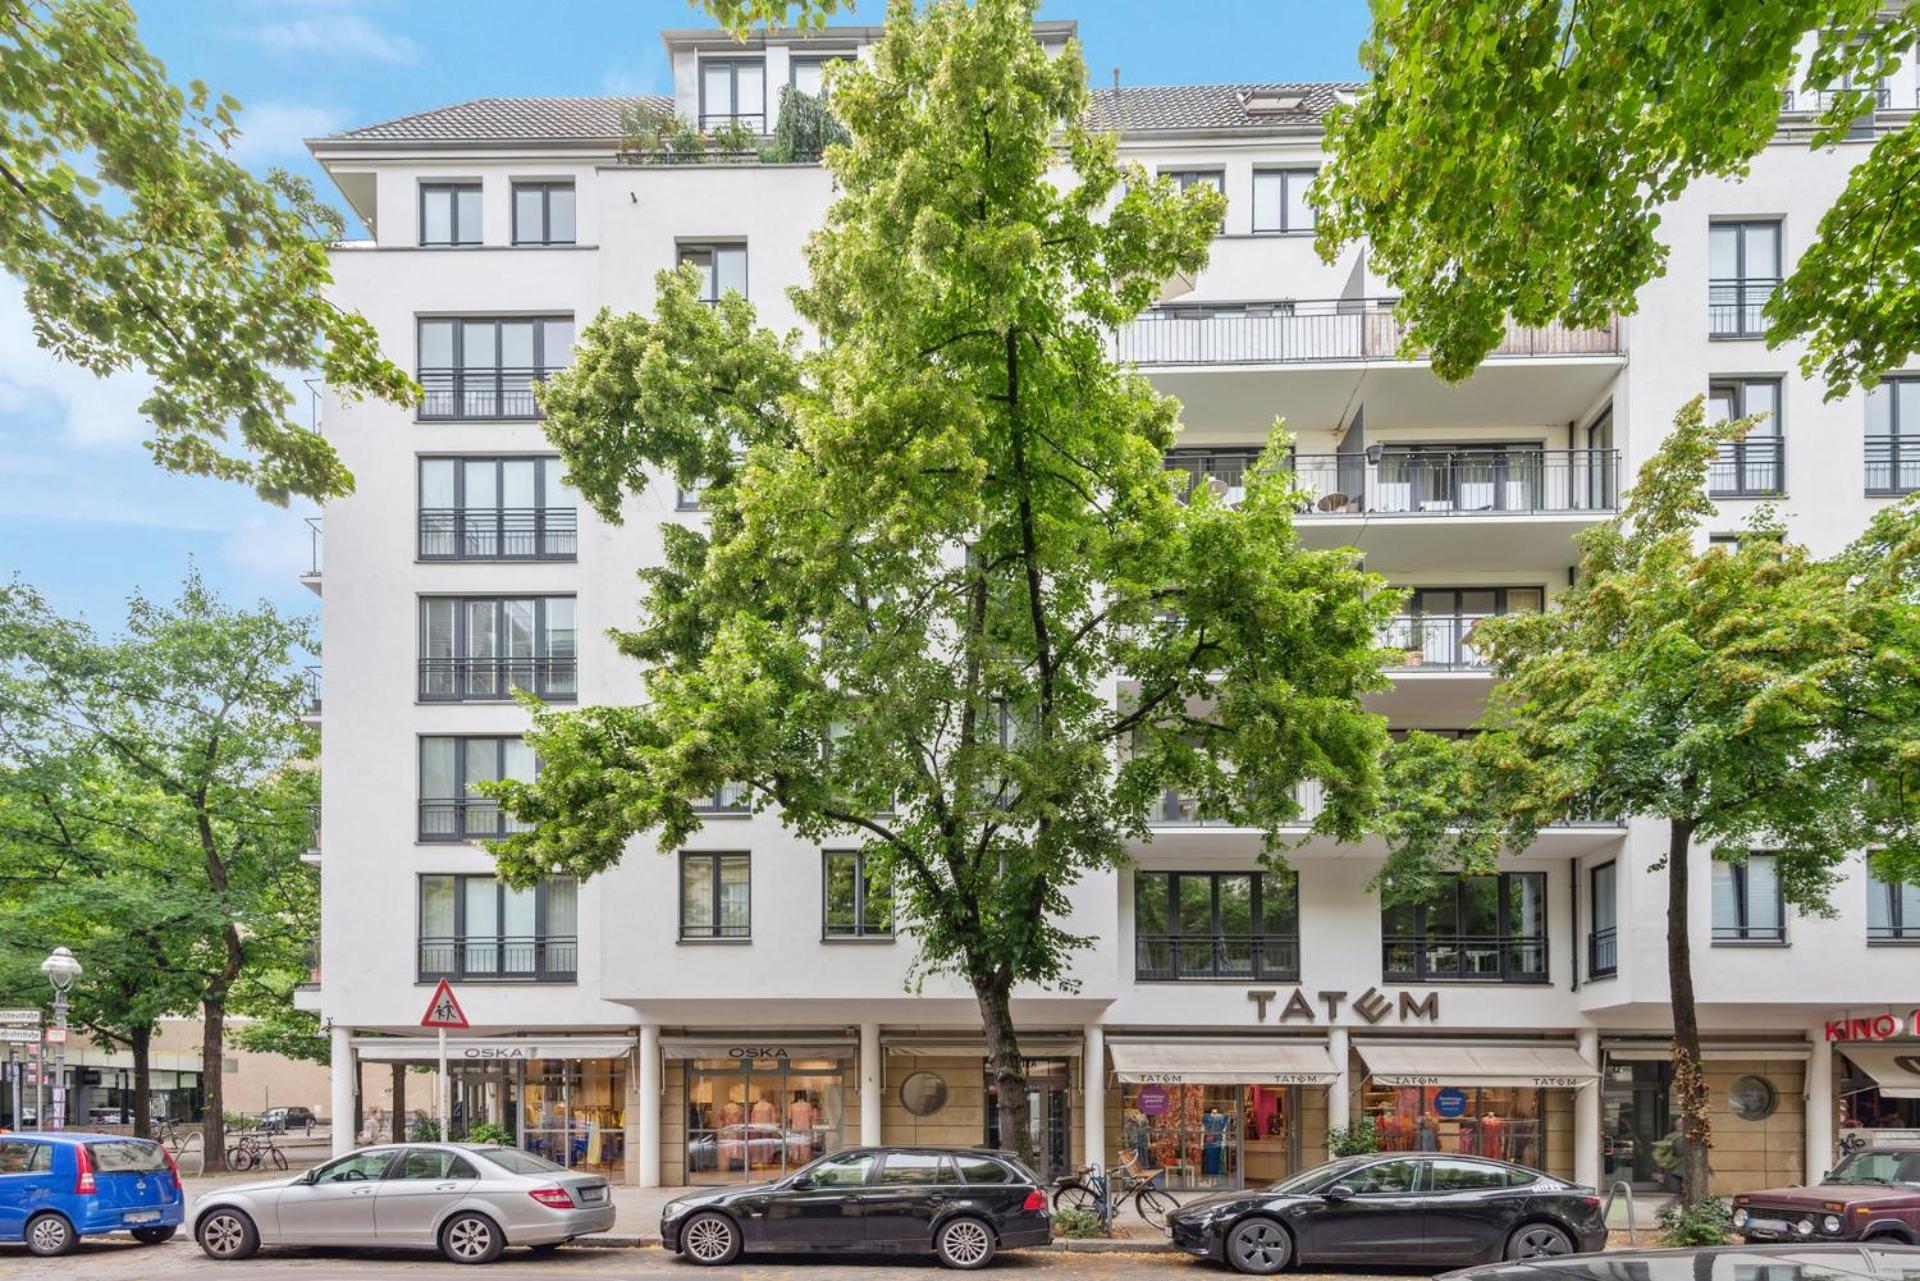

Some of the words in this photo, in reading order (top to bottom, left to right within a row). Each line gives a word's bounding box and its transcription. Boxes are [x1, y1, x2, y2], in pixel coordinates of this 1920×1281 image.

[1247, 987, 1439, 1024] TATEM
[1825, 1014, 1895, 1041] KINO
[464, 1047, 523, 1058] OSKA
[729, 1047, 789, 1058] OSKA
[1139, 1074, 1183, 1082] TATEM
[1274, 1075, 1317, 1083] TATEM
[1395, 1077, 1439, 1085] TATEM
[1533, 1078, 1577, 1086] TATEM
